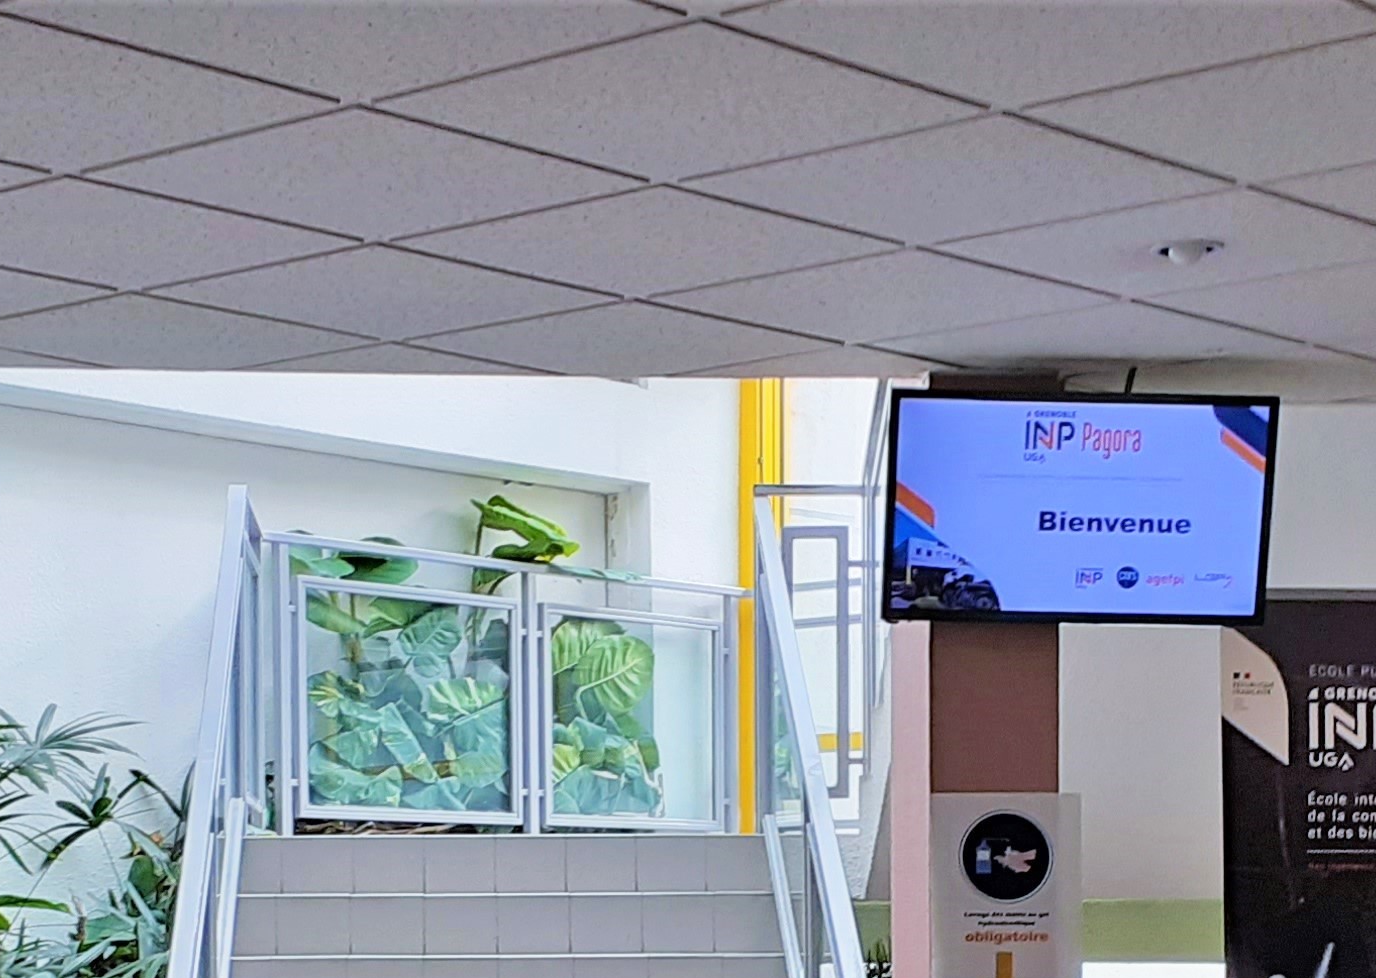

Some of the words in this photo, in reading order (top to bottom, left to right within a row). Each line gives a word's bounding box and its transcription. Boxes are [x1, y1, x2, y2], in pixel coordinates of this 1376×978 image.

[1024, 420, 1075, 451] INP
[1081, 421, 1142, 460] Pagora
[1037, 510, 1192, 535] Bienvenue
[1308, 664, 1355, 678] ÉCOLE
[1308, 751, 1354, 771] UGA
[1308, 790, 1347, 806] École
[1308, 810, 1325, 823] de
[1332, 809, 1345, 822] la
[1308, 826, 1322, 839] et
[1327, 826, 1354, 839] des
[965, 931, 1049, 945] obligatoire
